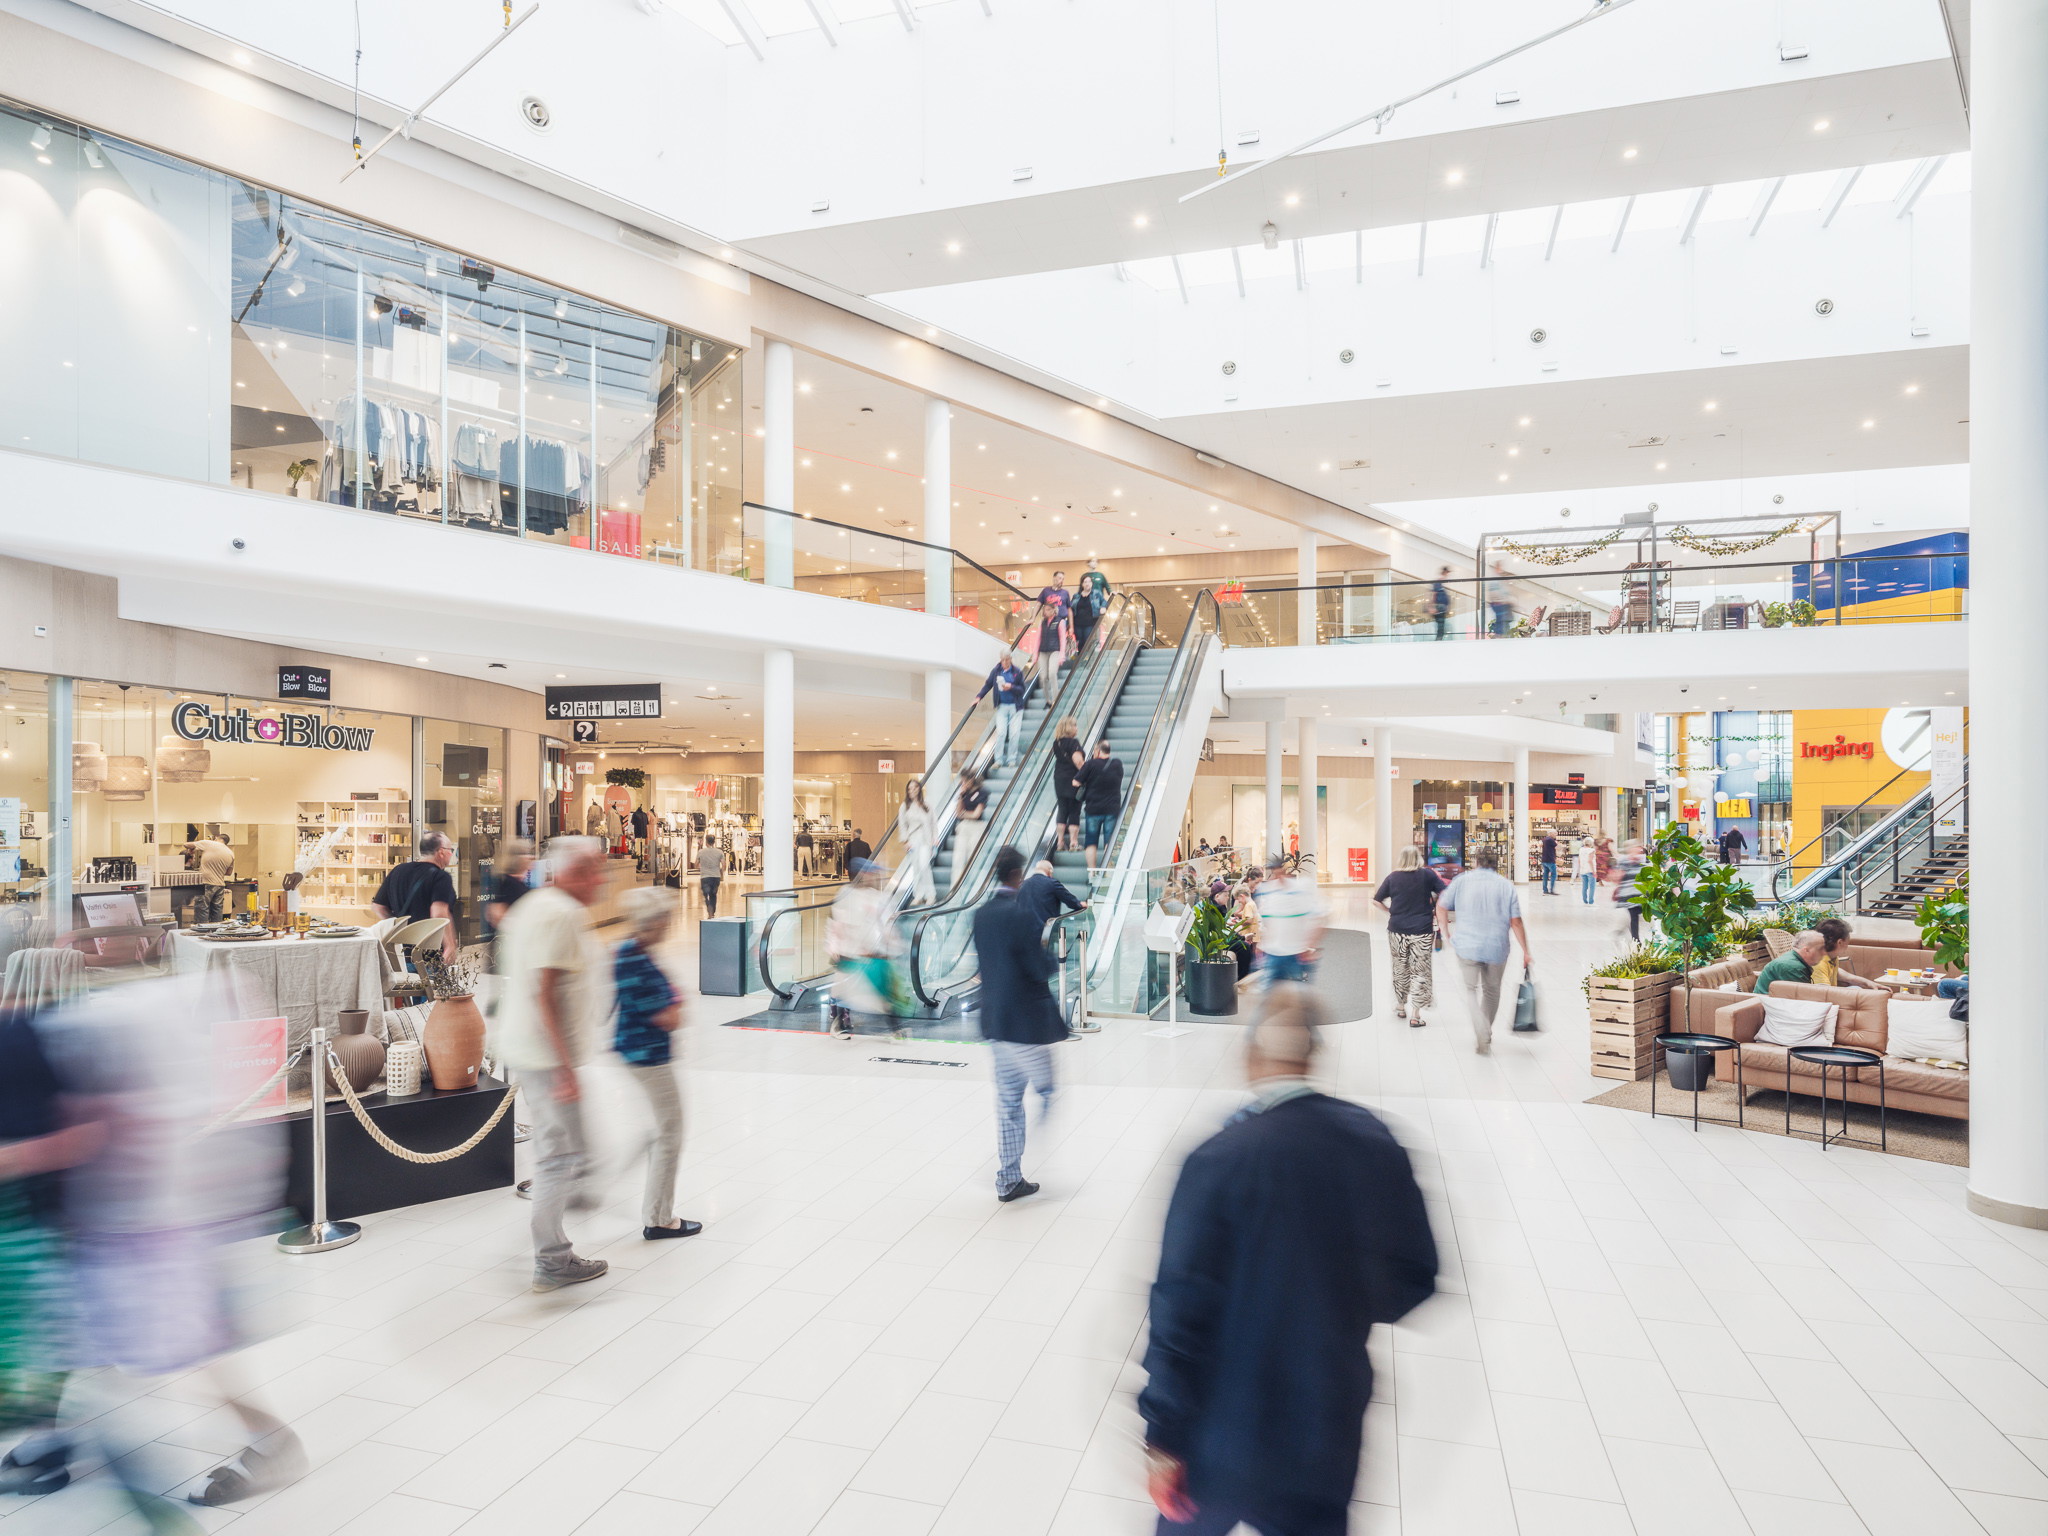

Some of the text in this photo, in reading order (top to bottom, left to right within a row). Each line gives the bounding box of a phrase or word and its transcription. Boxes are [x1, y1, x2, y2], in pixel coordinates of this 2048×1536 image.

[599, 540, 641, 557] SALE
[282, 674, 296, 682] Cut
[308, 675, 323, 684] Cut
[282, 683, 301, 691] Blow
[308, 684, 328, 693] Blow
[171, 702, 375, 752] Cut Blow
[1935, 731, 1958, 744] Hej!
[1800, 734, 1874, 761] Ingång
[694, 780, 718, 799] H&M
[1716, 799, 1752, 818] IKEA
[472, 824, 501, 834] Cut Blow
